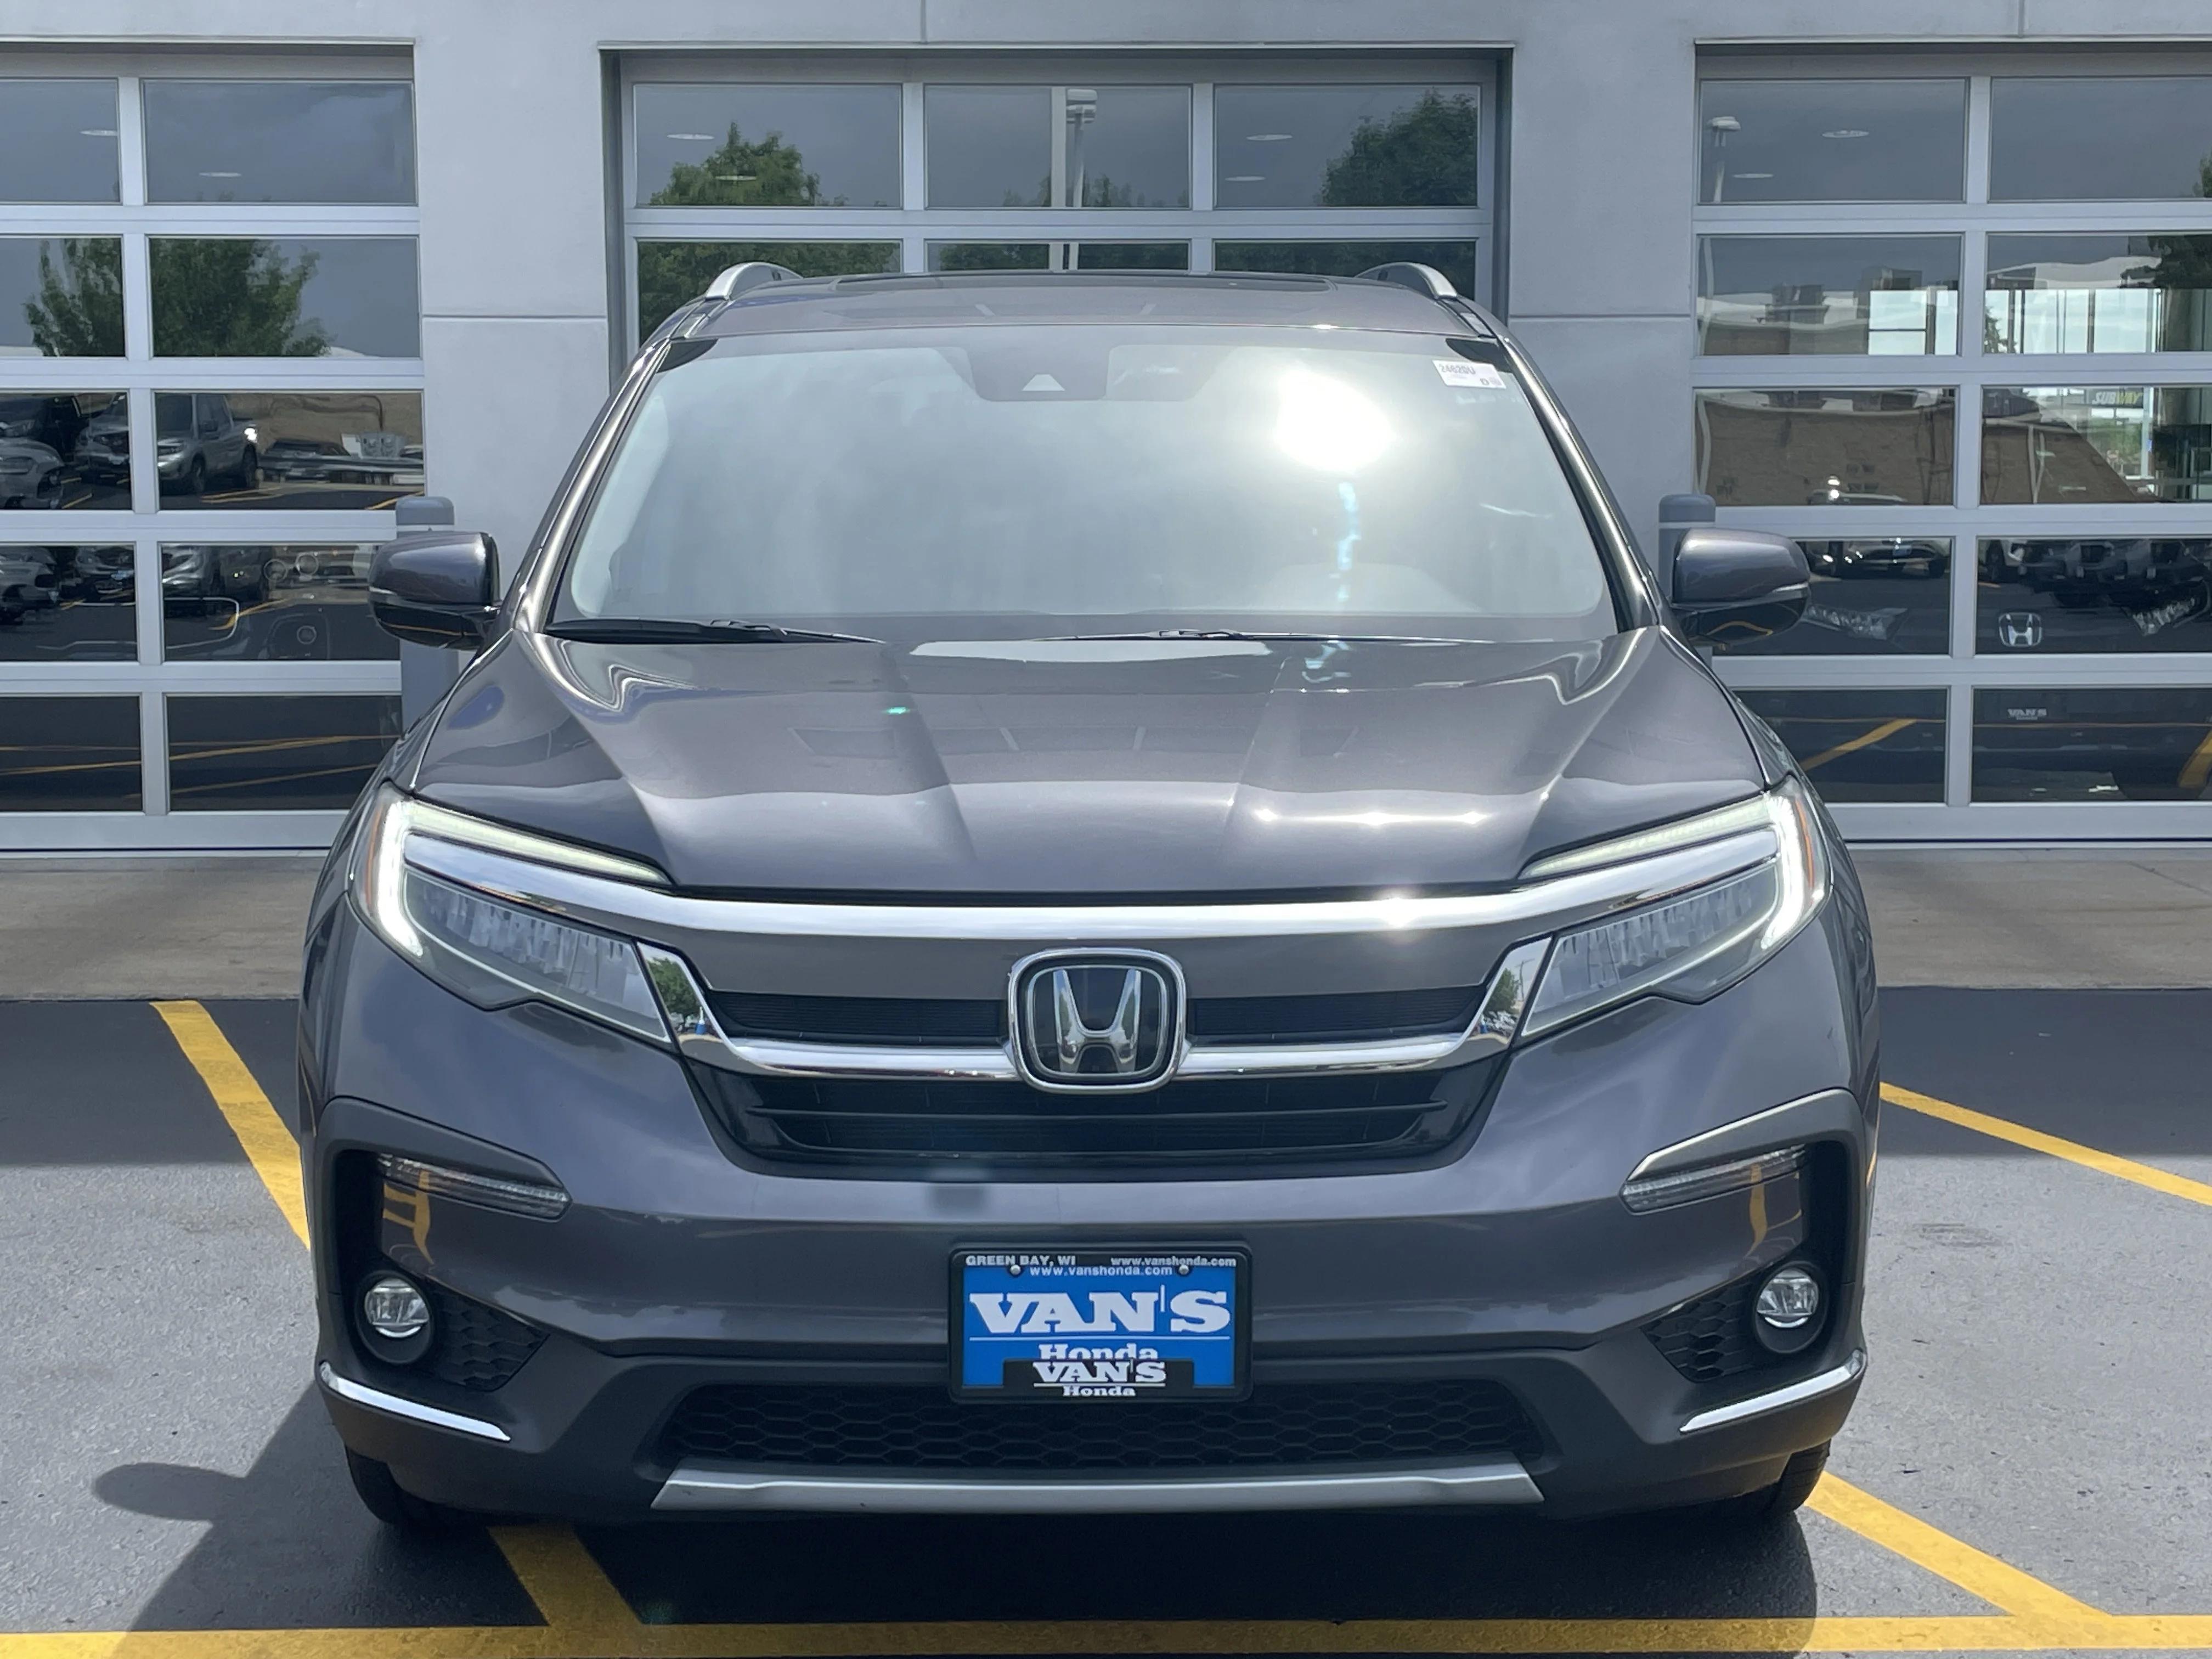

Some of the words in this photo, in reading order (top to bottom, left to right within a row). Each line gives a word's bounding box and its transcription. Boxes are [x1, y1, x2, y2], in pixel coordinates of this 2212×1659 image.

[2091, 391, 2144, 404] SUBWAY
[965, 1255, 1015, 1266] GREEN
[1019, 1255, 1054, 1267] BAY,
[1057, 1255, 1076, 1266] WI
[1111, 1255, 1237, 1267] www.vanshonda.com
[1029, 1266, 1173, 1277] www.vanshonda.com
[969, 1284, 1231, 1334] VAN'S
[1039, 1343, 1158, 1359] Honda
[1032, 1359, 1166, 1383] VAN'S
[1063, 1386, 1136, 1396] Honda
